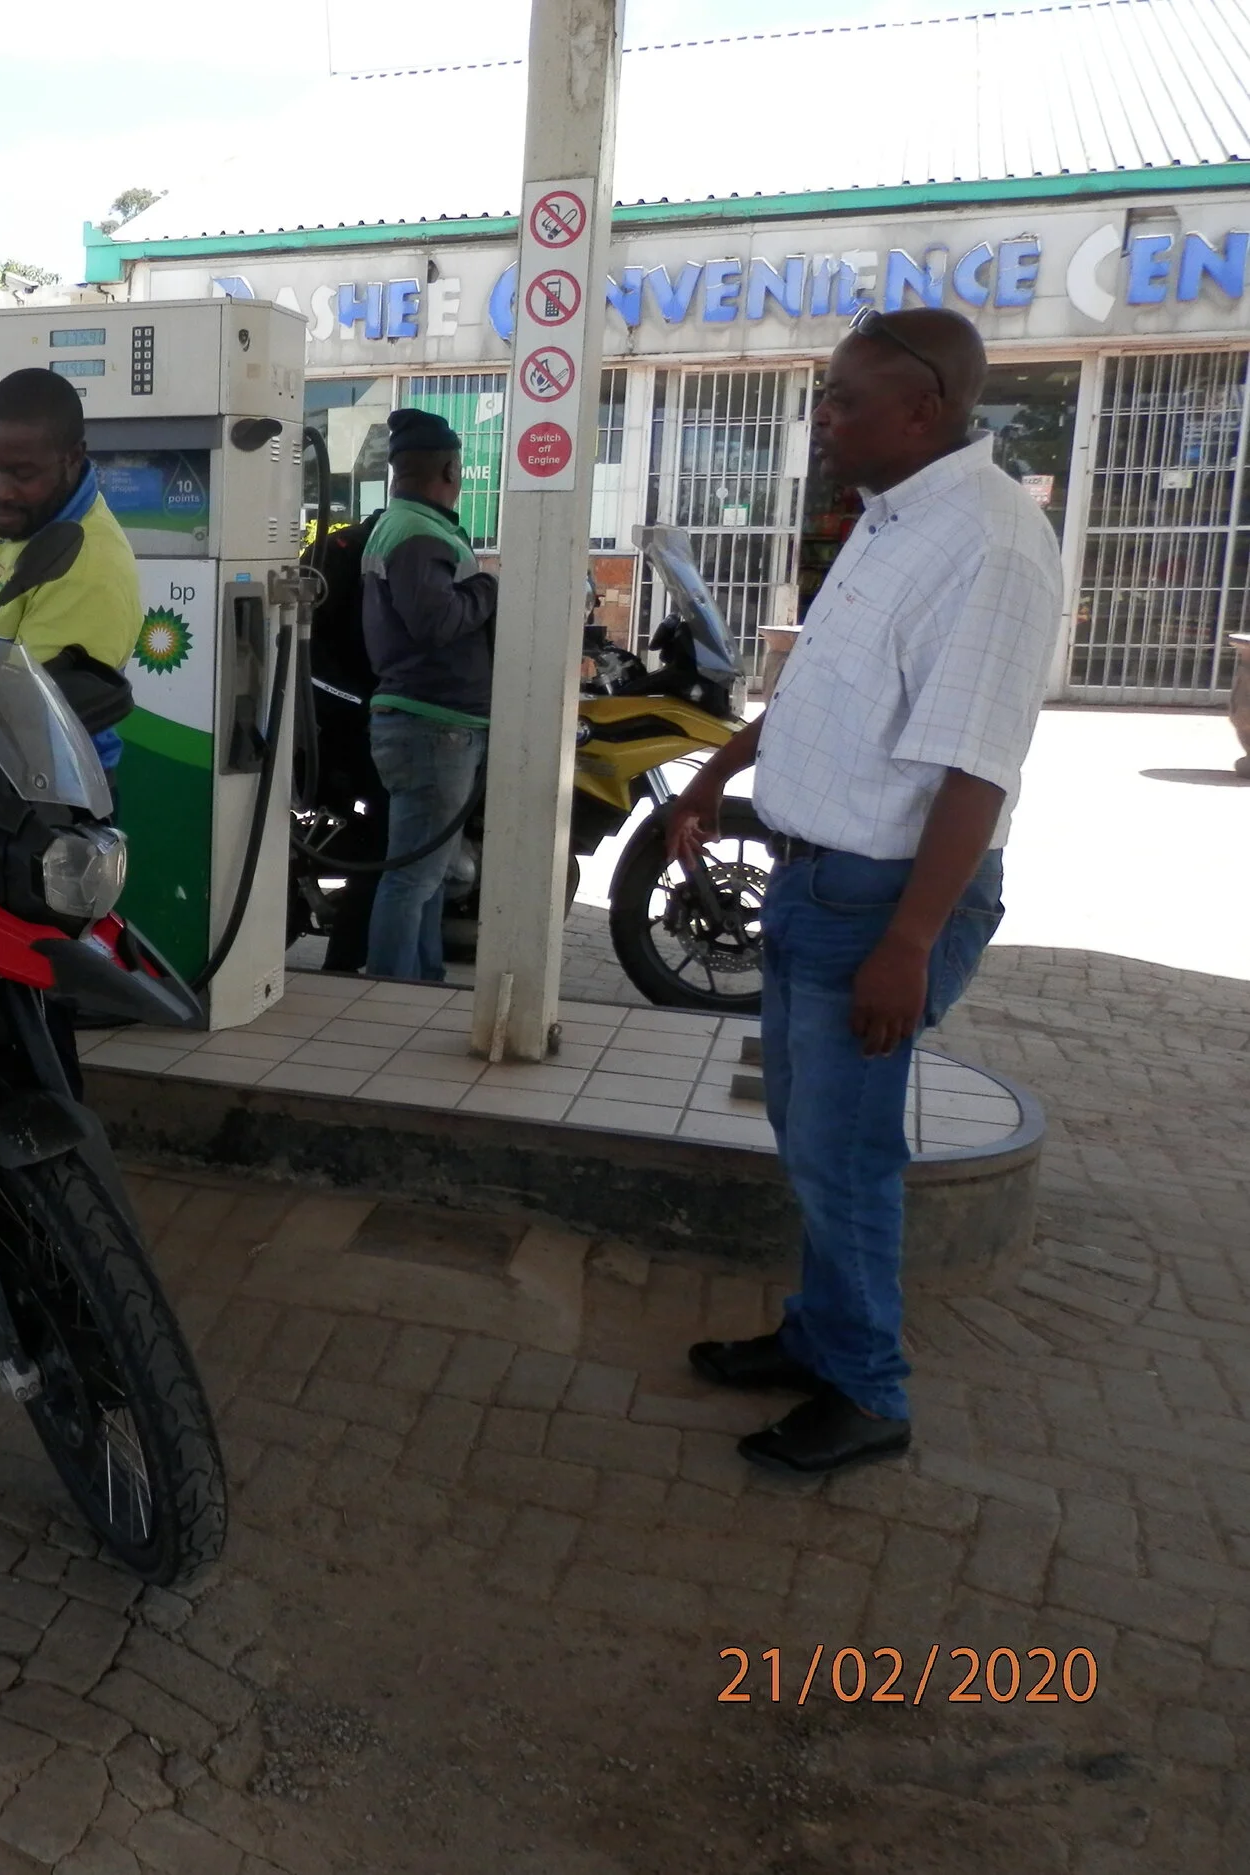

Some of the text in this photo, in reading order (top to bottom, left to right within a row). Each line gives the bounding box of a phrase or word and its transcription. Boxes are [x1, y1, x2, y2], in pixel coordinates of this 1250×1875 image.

[489, 230, 1041, 342] CNVENIENCE
[31, 336, 39, 345] R
[530, 433, 562, 442] Switch
[538, 445, 552, 453] off
[528, 455, 561, 466] Engine
[177, 480, 192, 493] 10
[168, 494, 200, 504] points
[170, 582, 195, 605] bp
